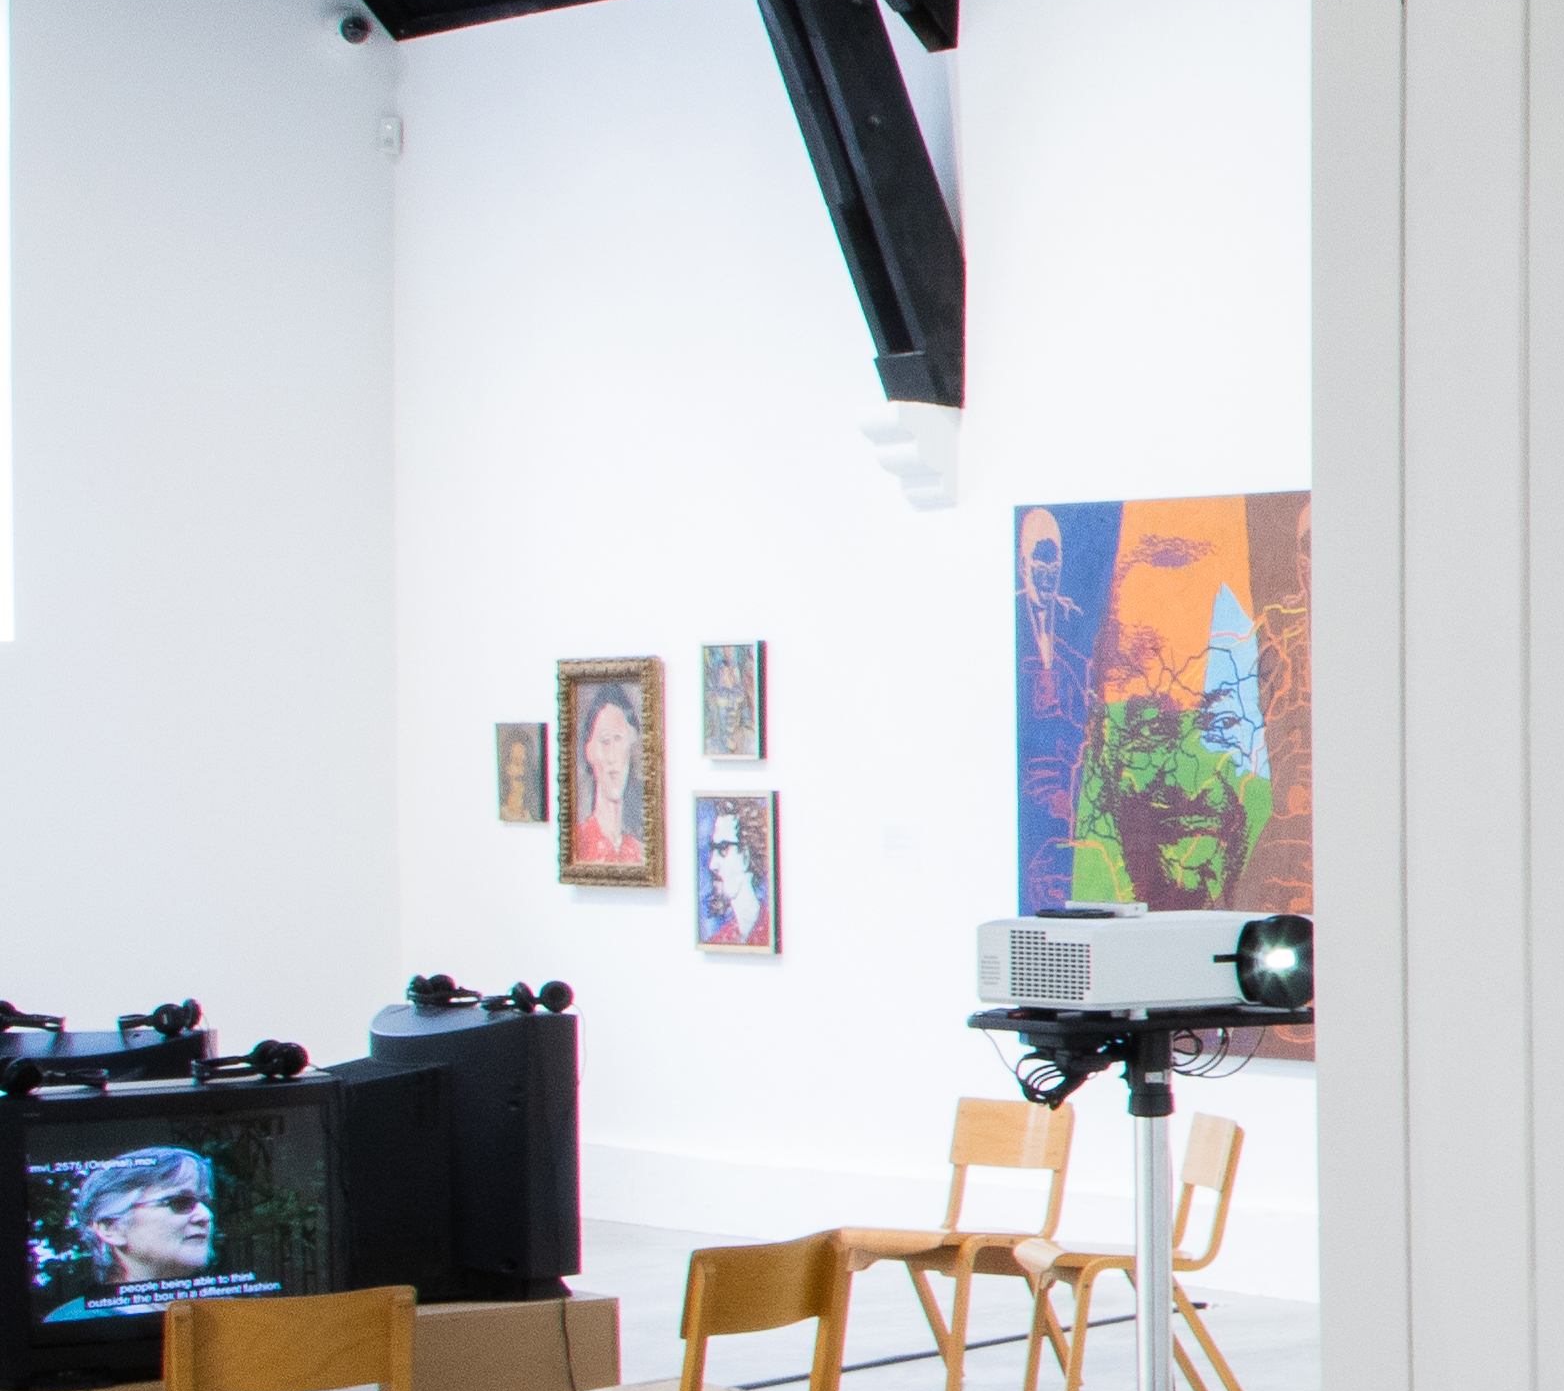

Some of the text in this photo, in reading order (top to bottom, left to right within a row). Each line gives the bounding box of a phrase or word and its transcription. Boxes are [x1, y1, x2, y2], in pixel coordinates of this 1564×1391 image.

[118, 1271, 256, 1295] people being able to think
[86, 1296, 131, 1310] outside
[131, 1294, 152, 1305] the
[153, 1292, 175, 1303] box
[176, 1290, 188, 1300] in
[198, 1284, 242, 1299] different
